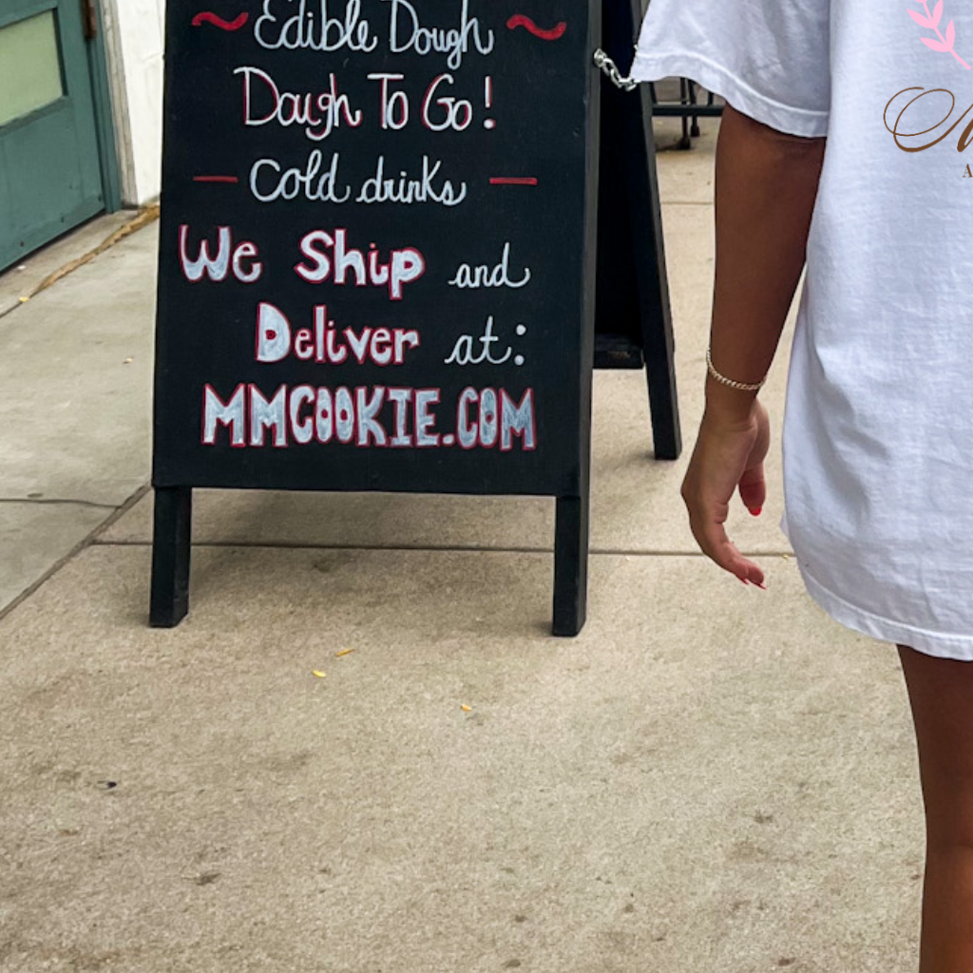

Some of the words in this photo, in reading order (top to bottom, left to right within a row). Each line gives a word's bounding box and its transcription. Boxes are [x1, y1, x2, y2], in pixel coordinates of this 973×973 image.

[234, 67, 362, 140] Dough
[368, 74, 409, 130] To
[250, 150, 350, 202] Cold
[180, 225, 261, 282] We
[295, 229, 425, 299] Ship
[448, 242, 530, 288] and
[256, 303, 419, 365] Deliver
[202, 384, 536, 450] MMCOOKIE.COM
